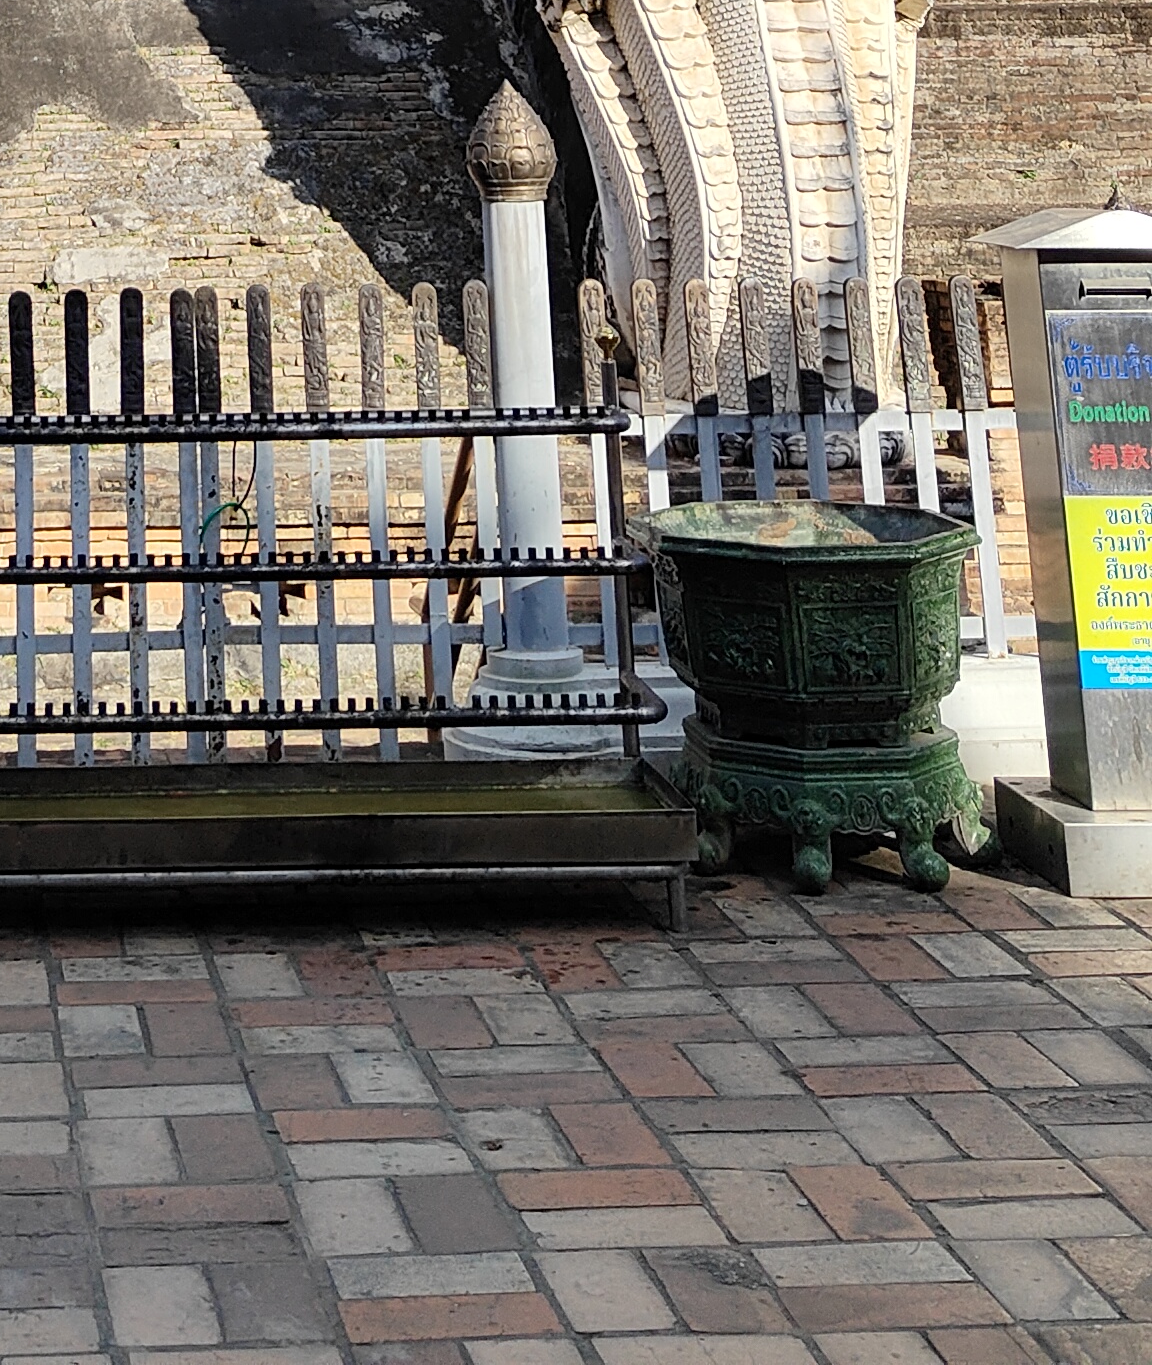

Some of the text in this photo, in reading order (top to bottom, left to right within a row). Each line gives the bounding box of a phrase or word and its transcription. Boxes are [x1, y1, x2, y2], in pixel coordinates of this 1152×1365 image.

[1068, 400, 1151, 423] Donation
[1089, 442, 1152, 471] 捐款
[1096, 584, 1152, 608] สักกา
